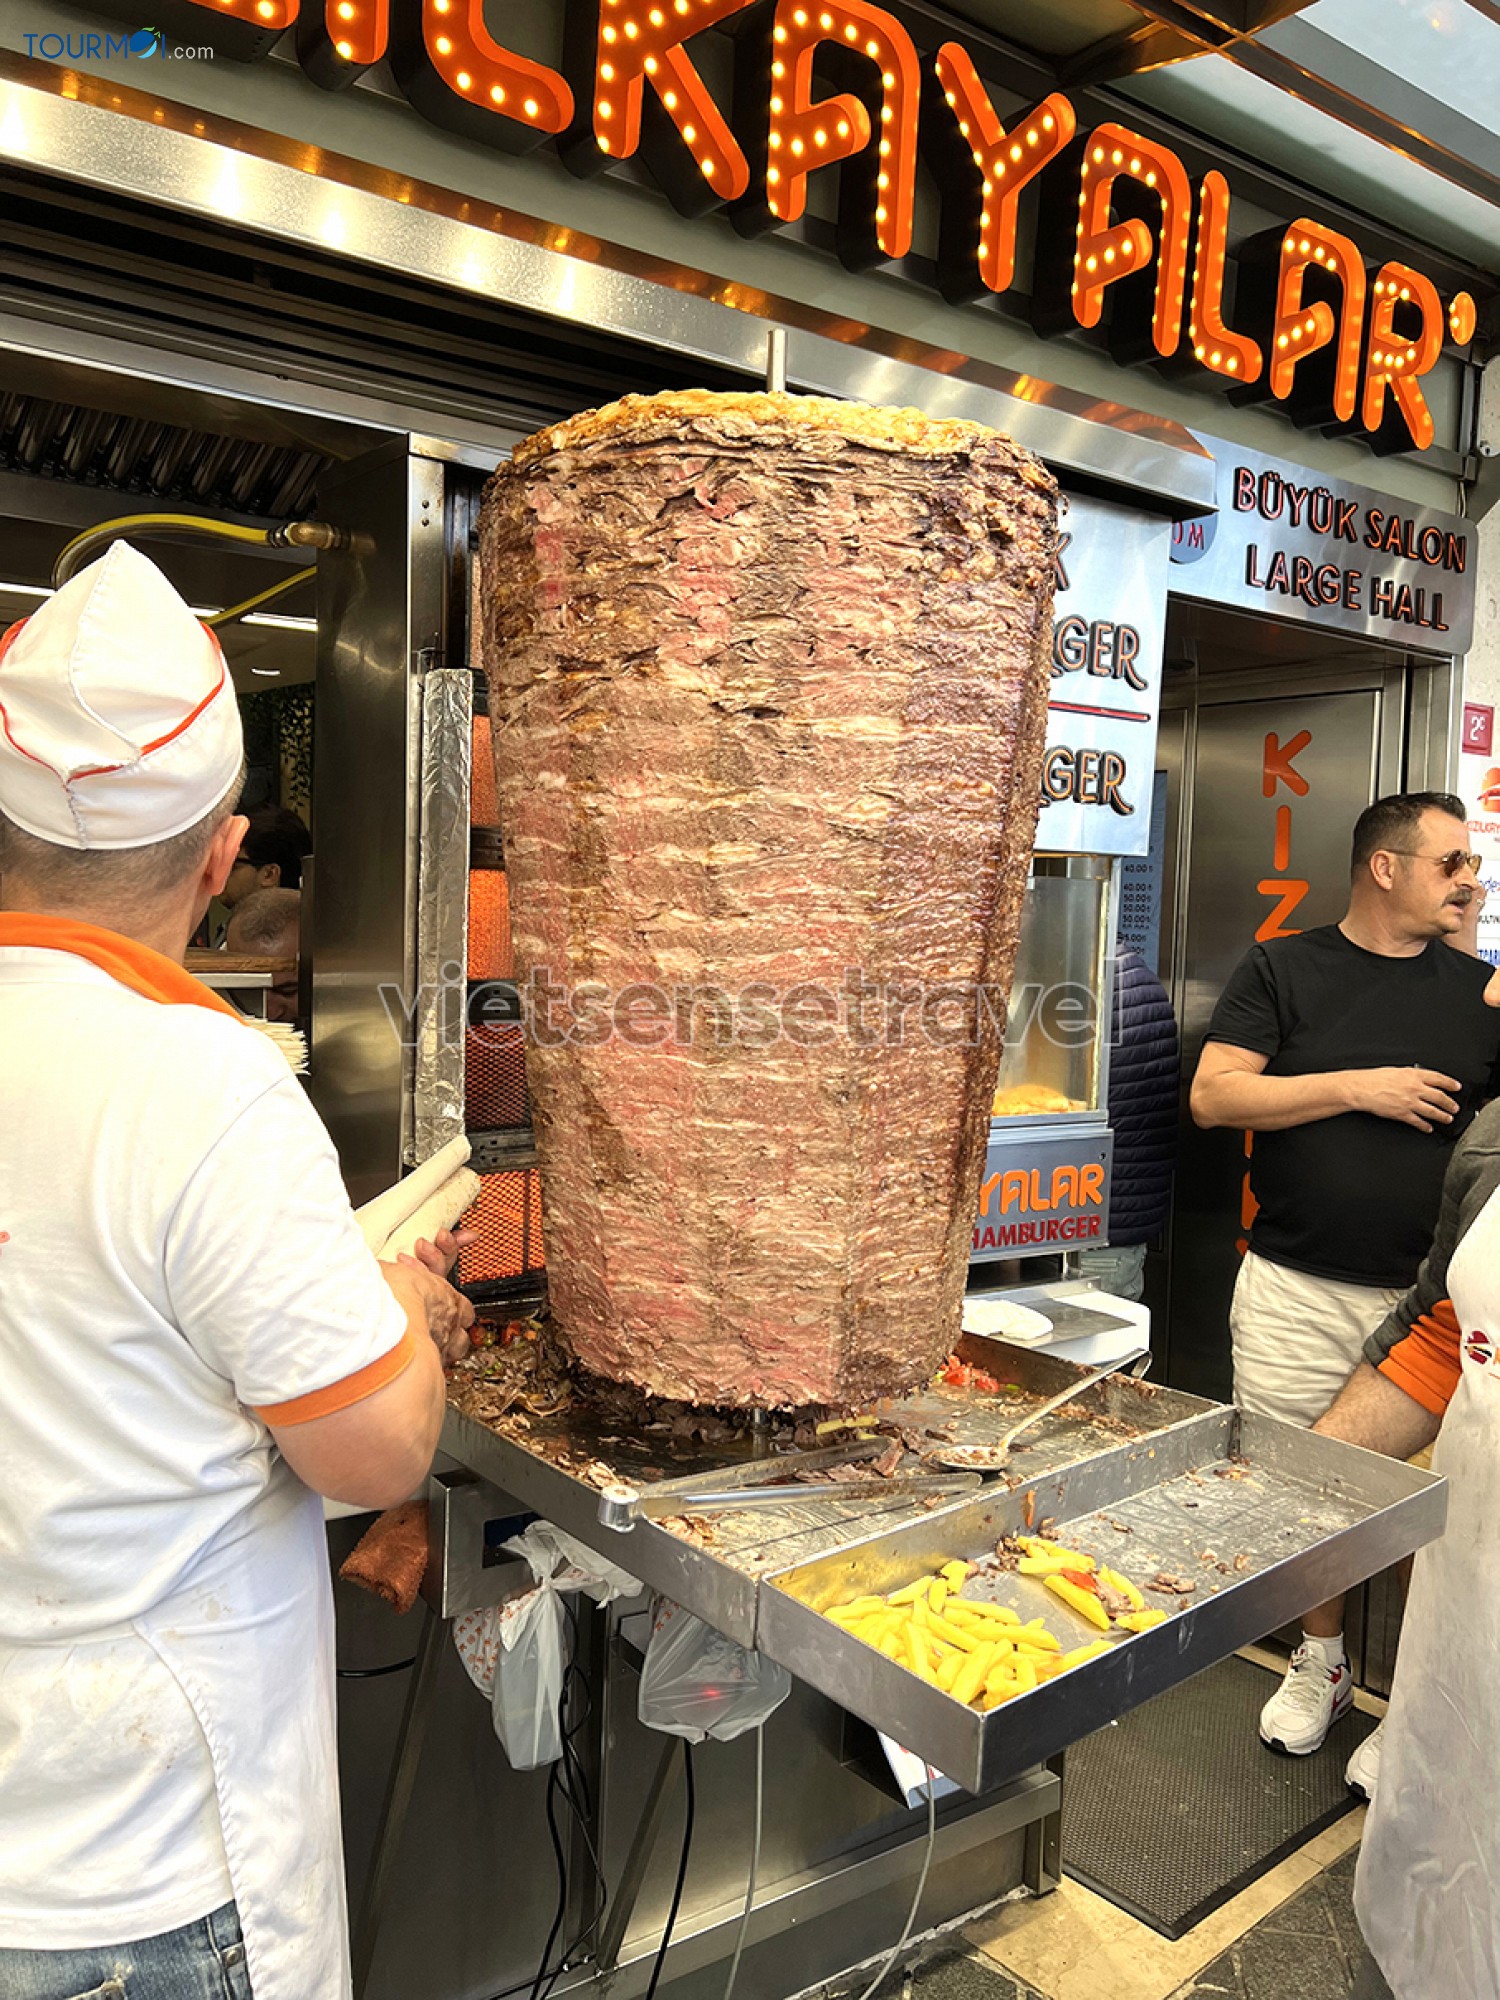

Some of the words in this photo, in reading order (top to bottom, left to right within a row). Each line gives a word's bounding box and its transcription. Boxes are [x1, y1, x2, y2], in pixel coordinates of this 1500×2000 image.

[1232, 466, 1358, 543] BÜYÜK
[1364, 508, 1466, 574] SALON
[1245, 543, 1362, 611] LARGE
[1369, 576, 1449, 631] HALL
[1051, 613, 1148, 692] GER
[1039, 744, 1135, 817] GER
[979, 1163, 1105, 1217] YALAR
[970, 1214, 1102, 1251] HAMBURGER
